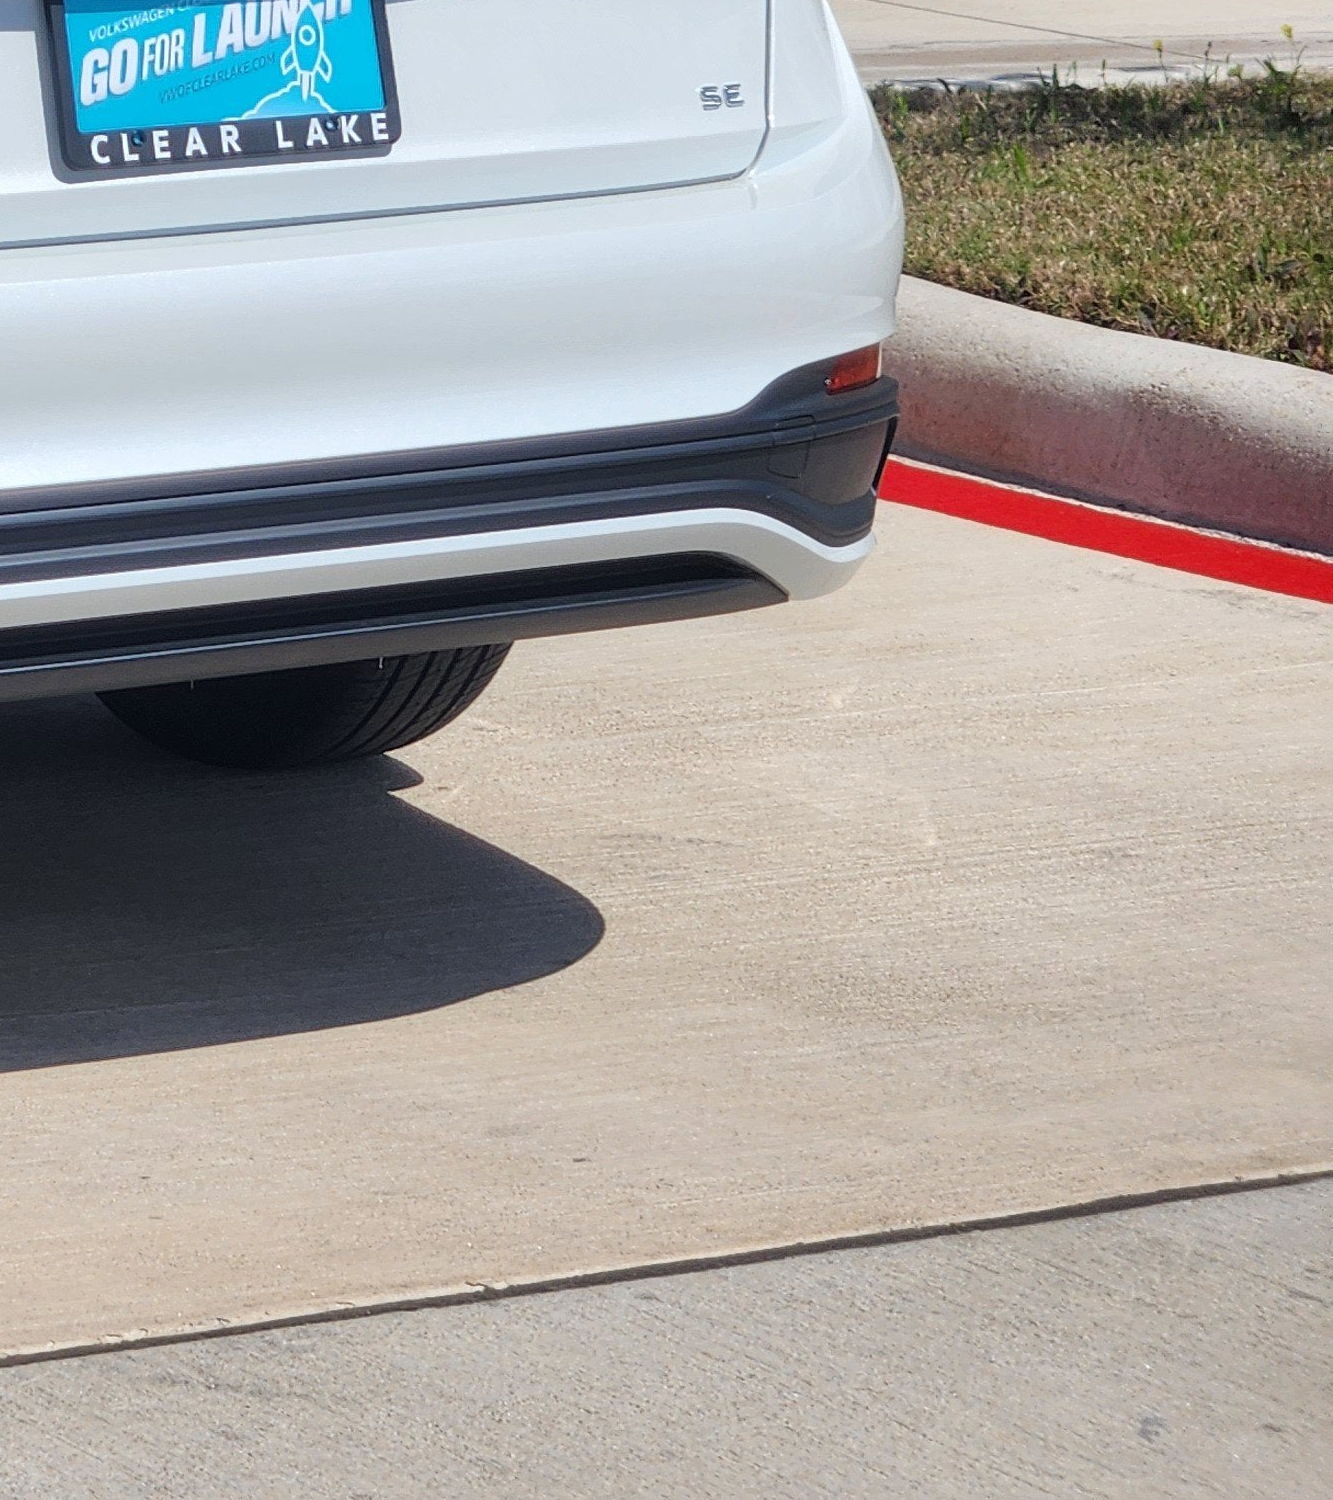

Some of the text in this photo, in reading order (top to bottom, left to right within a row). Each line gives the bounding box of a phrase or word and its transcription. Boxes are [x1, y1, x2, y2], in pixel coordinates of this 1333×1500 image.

[88, 3, 176, 43] VOLKSWAGEN
[80, 37, 139, 106] GO
[141, 28, 186, 81] FOR
[699, 83, 745, 111] SE
[89, 112, 390, 165] CLEAR LAKE
